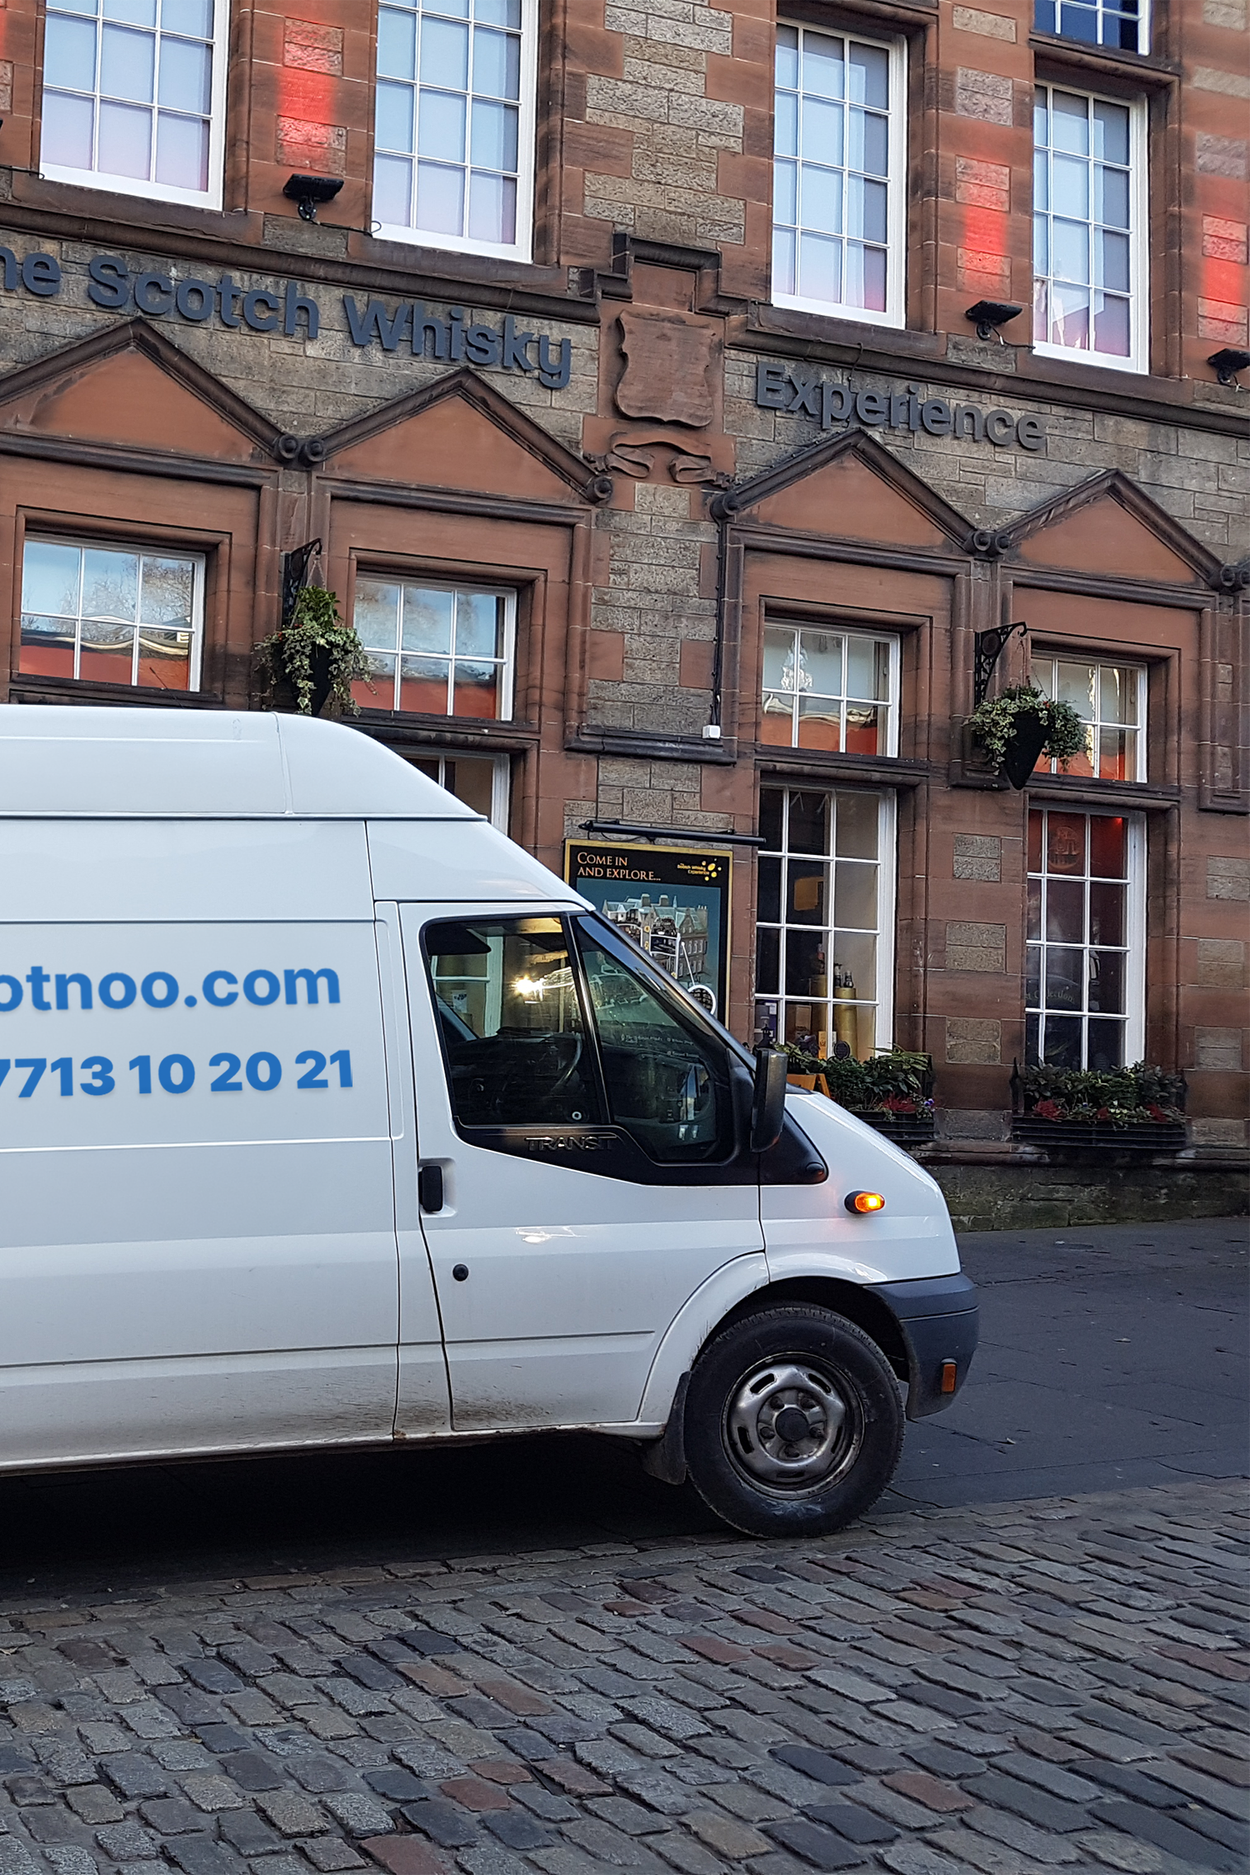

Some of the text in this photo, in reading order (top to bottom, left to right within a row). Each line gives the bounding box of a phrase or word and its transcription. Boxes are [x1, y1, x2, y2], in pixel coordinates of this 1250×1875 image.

[86, 254, 320, 340] Scotch
[343, 294, 572, 390] Whisky
[755, 360, 1047, 451] Experience
[577, 867, 604, 877] AND
[129, 1054, 195, 1094] 10
[209, 1052, 282, 1092] 20
[295, 1050, 353, 1089] 21
